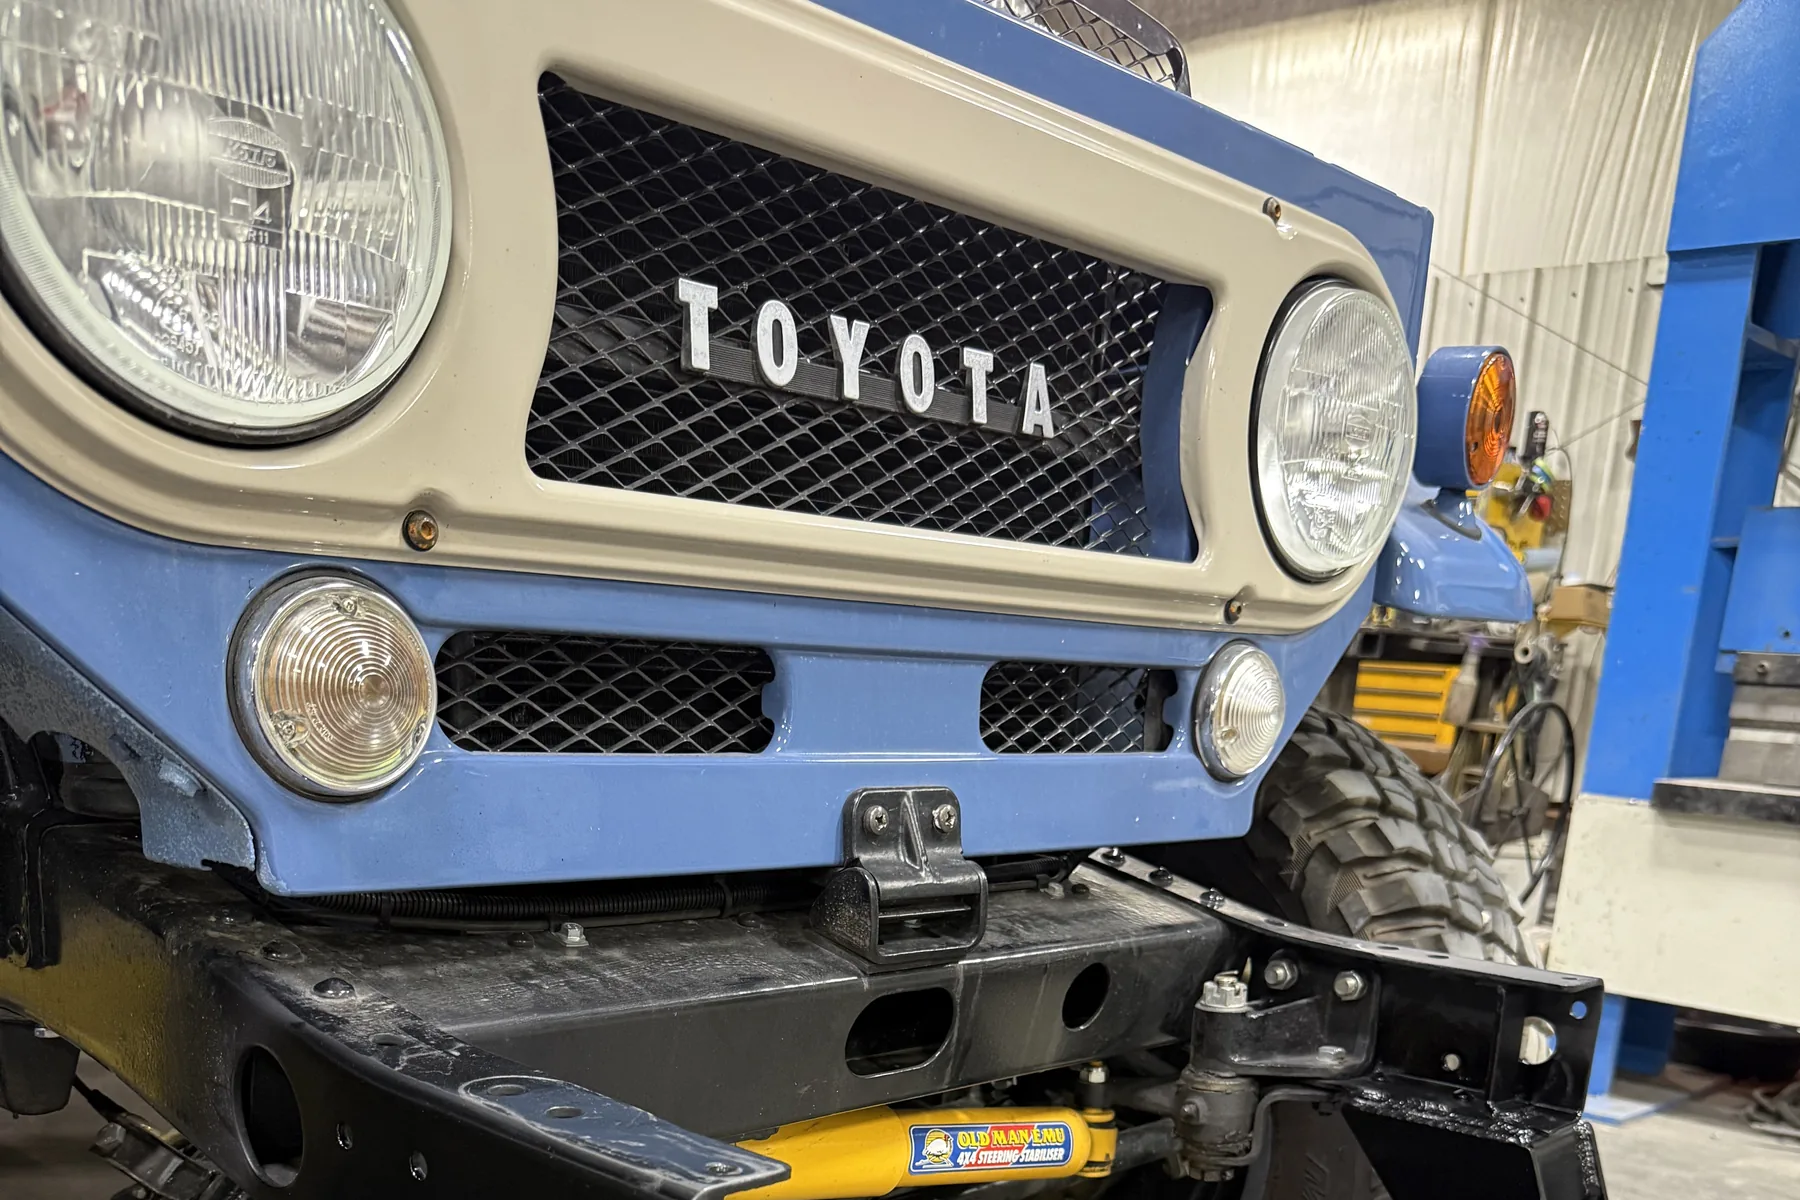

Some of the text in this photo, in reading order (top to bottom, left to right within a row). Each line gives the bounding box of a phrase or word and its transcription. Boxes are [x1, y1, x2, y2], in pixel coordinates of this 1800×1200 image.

[678, 277, 1054, 439] TOYOTA
[957, 1127, 1066, 1149] OLD MAN EMU
[957, 1147, 1065, 1166] 4X4 STEERING STABILISER
